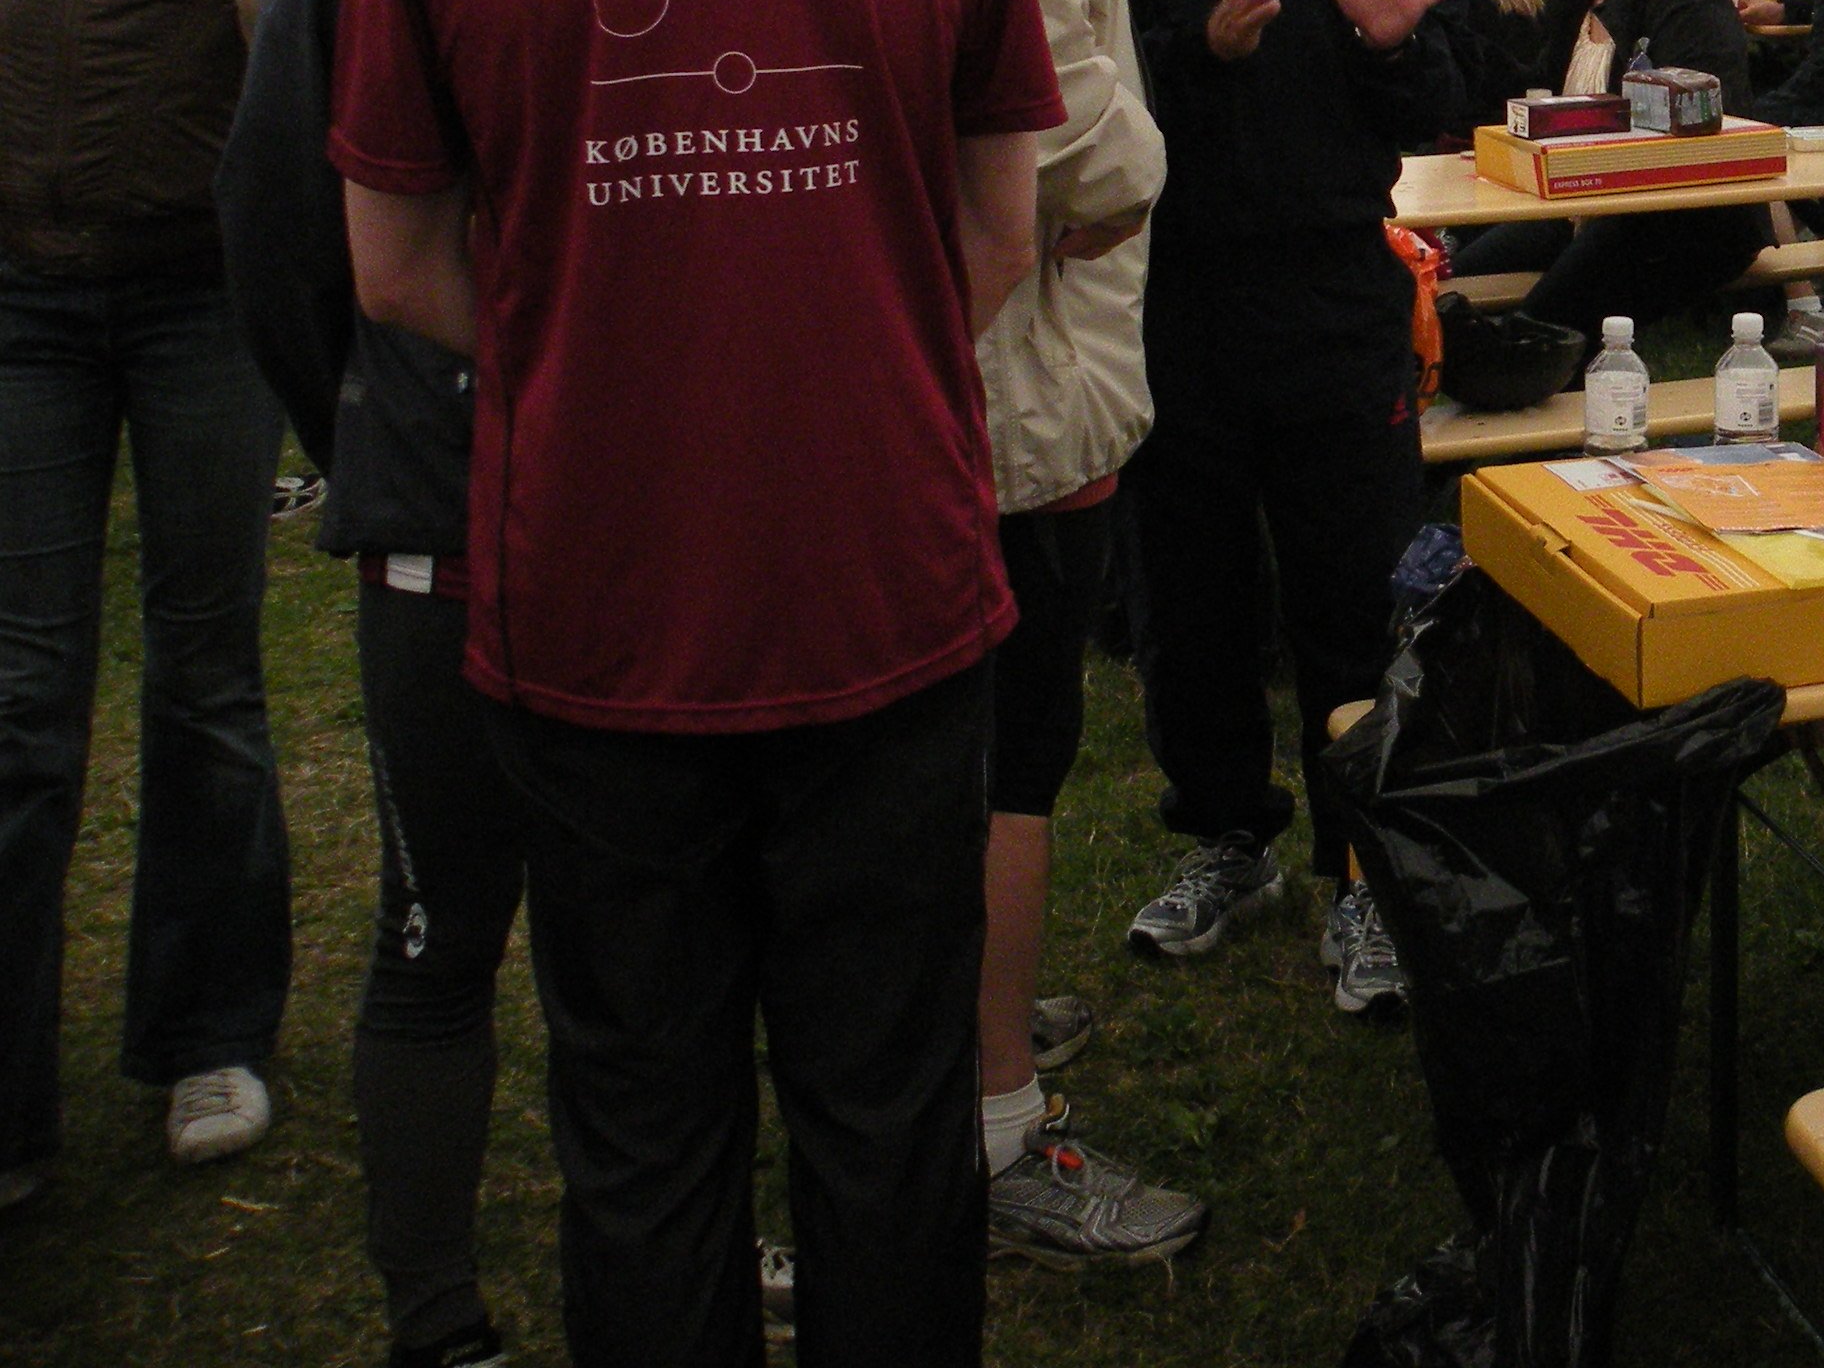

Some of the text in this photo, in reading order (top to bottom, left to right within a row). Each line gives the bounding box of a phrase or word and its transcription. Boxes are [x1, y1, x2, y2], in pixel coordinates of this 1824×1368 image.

[585, 119, 859, 164] KØBENHAVNS
[587, 160, 860, 206] UNIVERSITET
[1576, 508, 1708, 577] DHL
